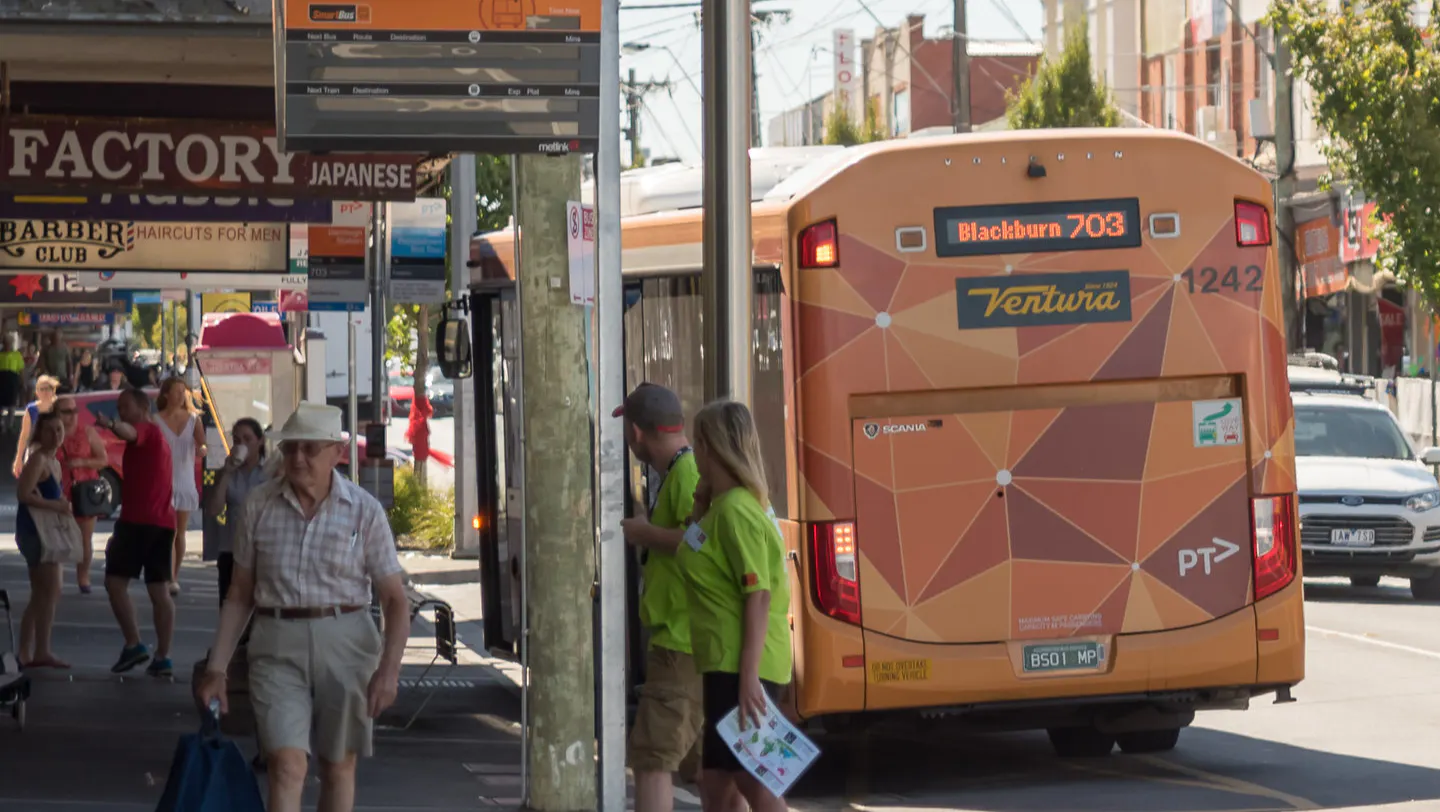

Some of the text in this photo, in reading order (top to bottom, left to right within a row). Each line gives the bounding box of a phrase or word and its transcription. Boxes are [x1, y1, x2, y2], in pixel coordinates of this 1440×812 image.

[8, 128, 296, 184] FACTORY
[538, 142, 569, 152] metlink
[308, 162, 413, 189] JAPANESE
[0, 220, 125, 246] BARBER
[136, 226, 282, 242] HAIRCUTS FOR MEN
[957, 211, 1125, 242] Blackburn 703
[35, 246, 88, 263] CLUB
[47, 271, 99, 292] na
[1180, 264, 1264, 294] 1242
[967, 284, 1121, 318] Ventura
[882, 423, 927, 434] SCANIA
[1077, 649, 1097, 665] MP
